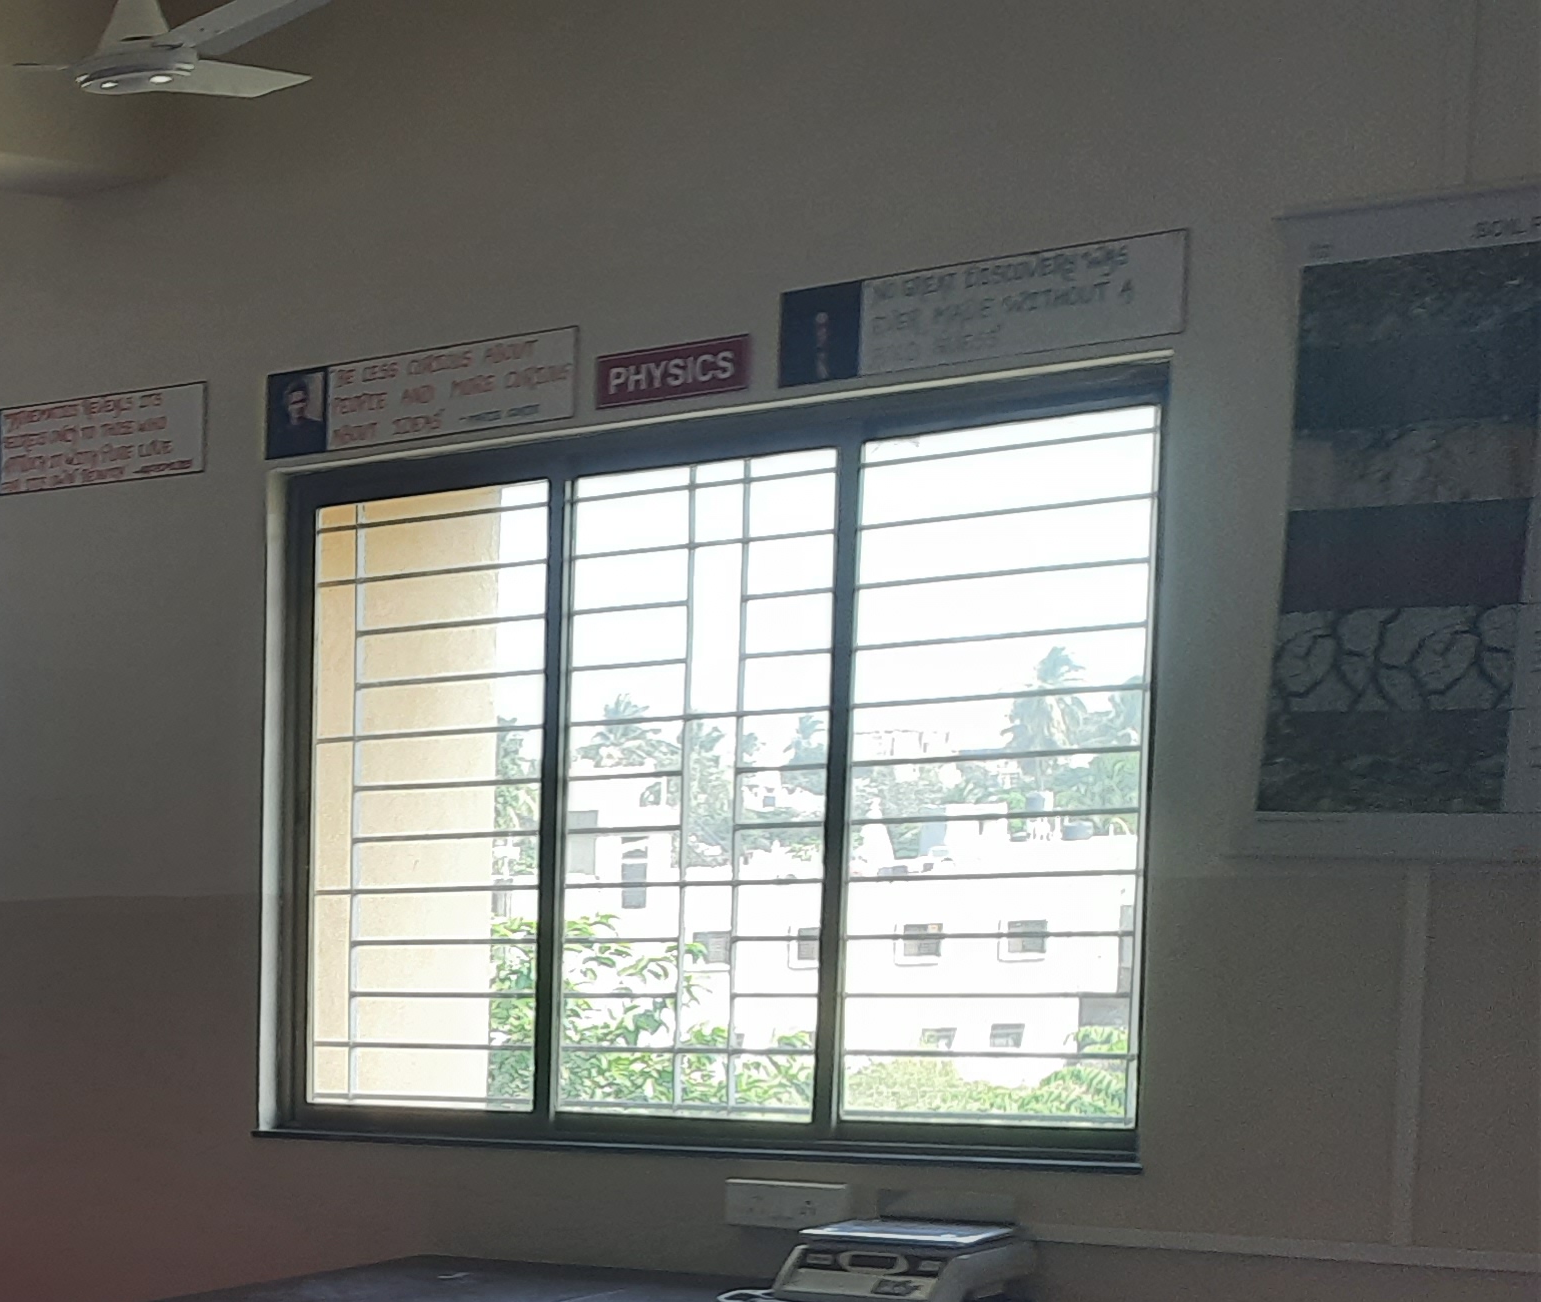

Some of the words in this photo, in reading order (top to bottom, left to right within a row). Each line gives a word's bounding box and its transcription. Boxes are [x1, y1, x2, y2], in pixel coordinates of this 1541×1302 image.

[965, 253, 1077, 289] DISCOVERY
[1002, 281, 1111, 313] WITHOUT
[607, 350, 735, 395] PHYSICS
